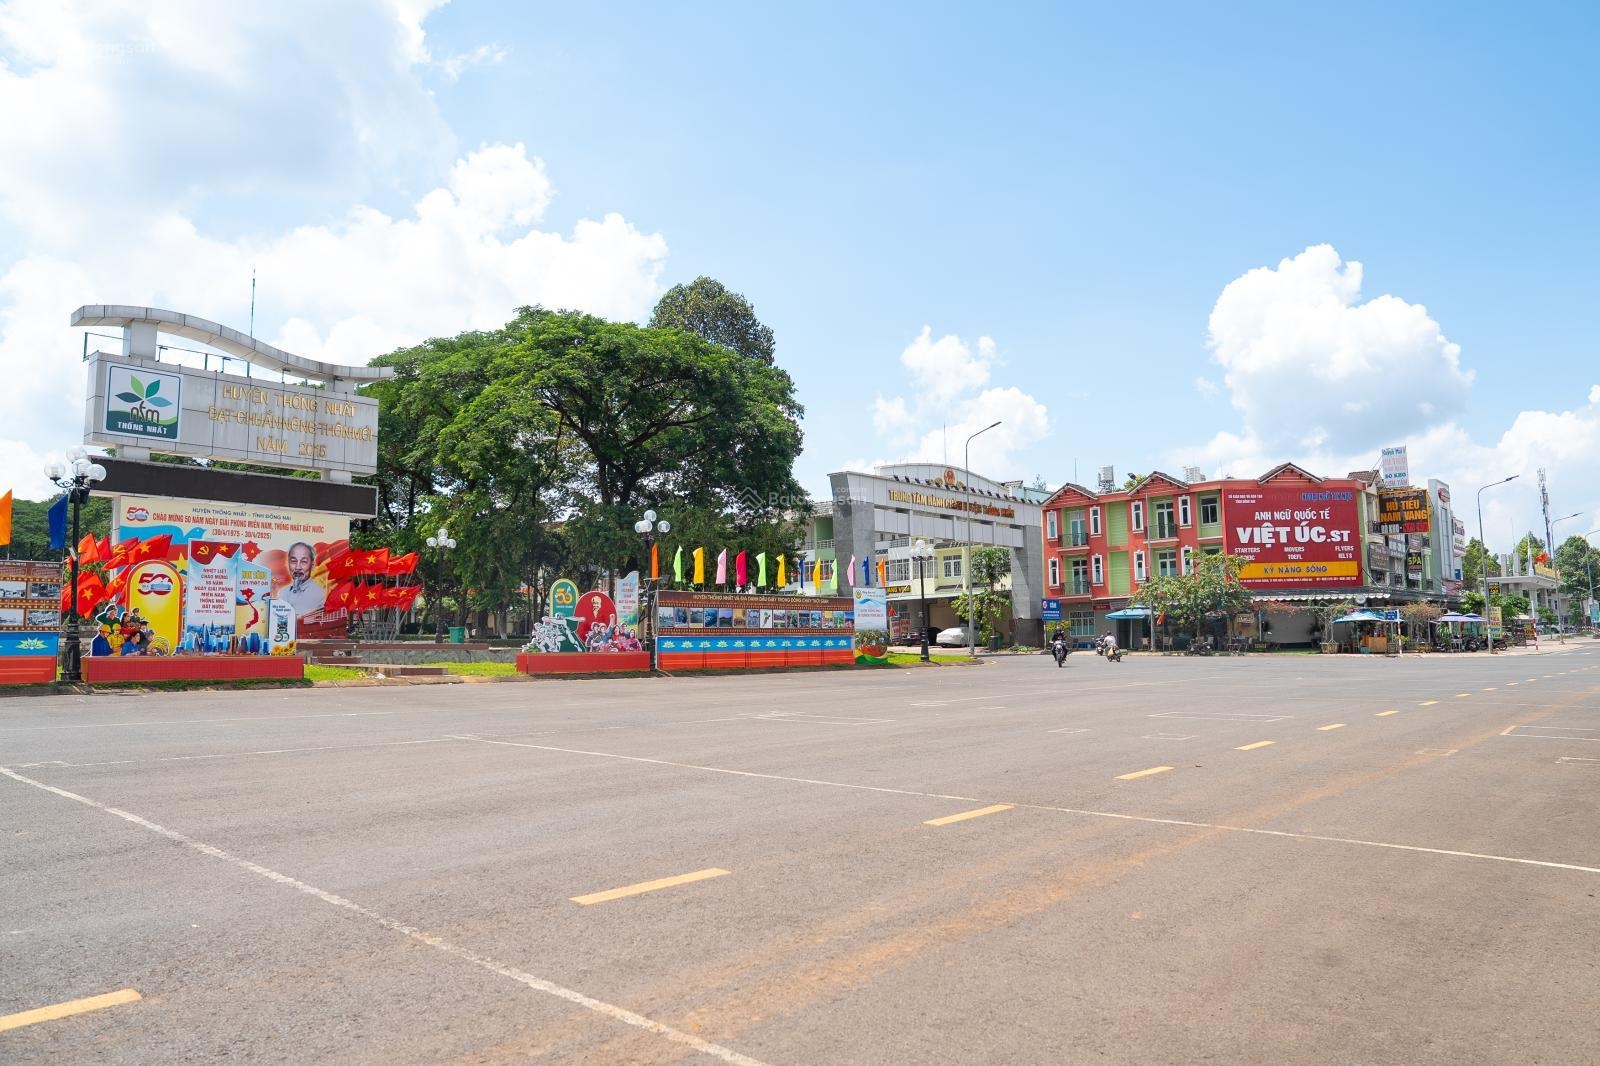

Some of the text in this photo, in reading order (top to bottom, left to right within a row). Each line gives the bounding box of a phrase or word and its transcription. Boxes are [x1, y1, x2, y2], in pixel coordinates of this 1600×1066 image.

[223, 384, 357, 419] HUYỆN THỐNG NHẤT
[117, 421, 168, 434] THỐNG NHẤT
[208, 405, 374, 443] ĐẠT CHUẨN NÔNG THÔN MỚI
[256, 435, 288, 454] NĂM
[889, 490, 911, 503] TRUNG
[911, 492, 927, 505] TÂM
[927, 494, 945, 508] HÀNH
[1386, 496, 1420, 512] HỦ TIẾU
[192, 507, 210, 515] HUYỆN
[1254, 507, 1331, 521] ANH NGỮ QUỐC TẾ
[1380, 509, 1428, 522] NAM VANG
[153, 512, 167, 521] CHÀO
[168, 513, 184, 523] MỪNG
[192, 515, 204, 524] NĂM
[205, 516, 218, 526] NGÀY
[219, 517, 230, 526] GIẢI
[231, 518, 247, 528] PHÓNG
[248, 519, 260, 528] MIỀN
[274, 521, 289, 531] THỐNG
[290, 523, 302, 532] NHẤT
[302, 523, 311, 532] ĐẤT
[312, 524, 324, 534] NƯỚC
[1236, 522, 1290, 548] VIỆT
[1278, 564, 1302, 573] NĂNG
[1306, 563, 1328, 573] SỐNG
[1408, 556, 1422, 565] SPA
[137, 573, 173, 596] 50
